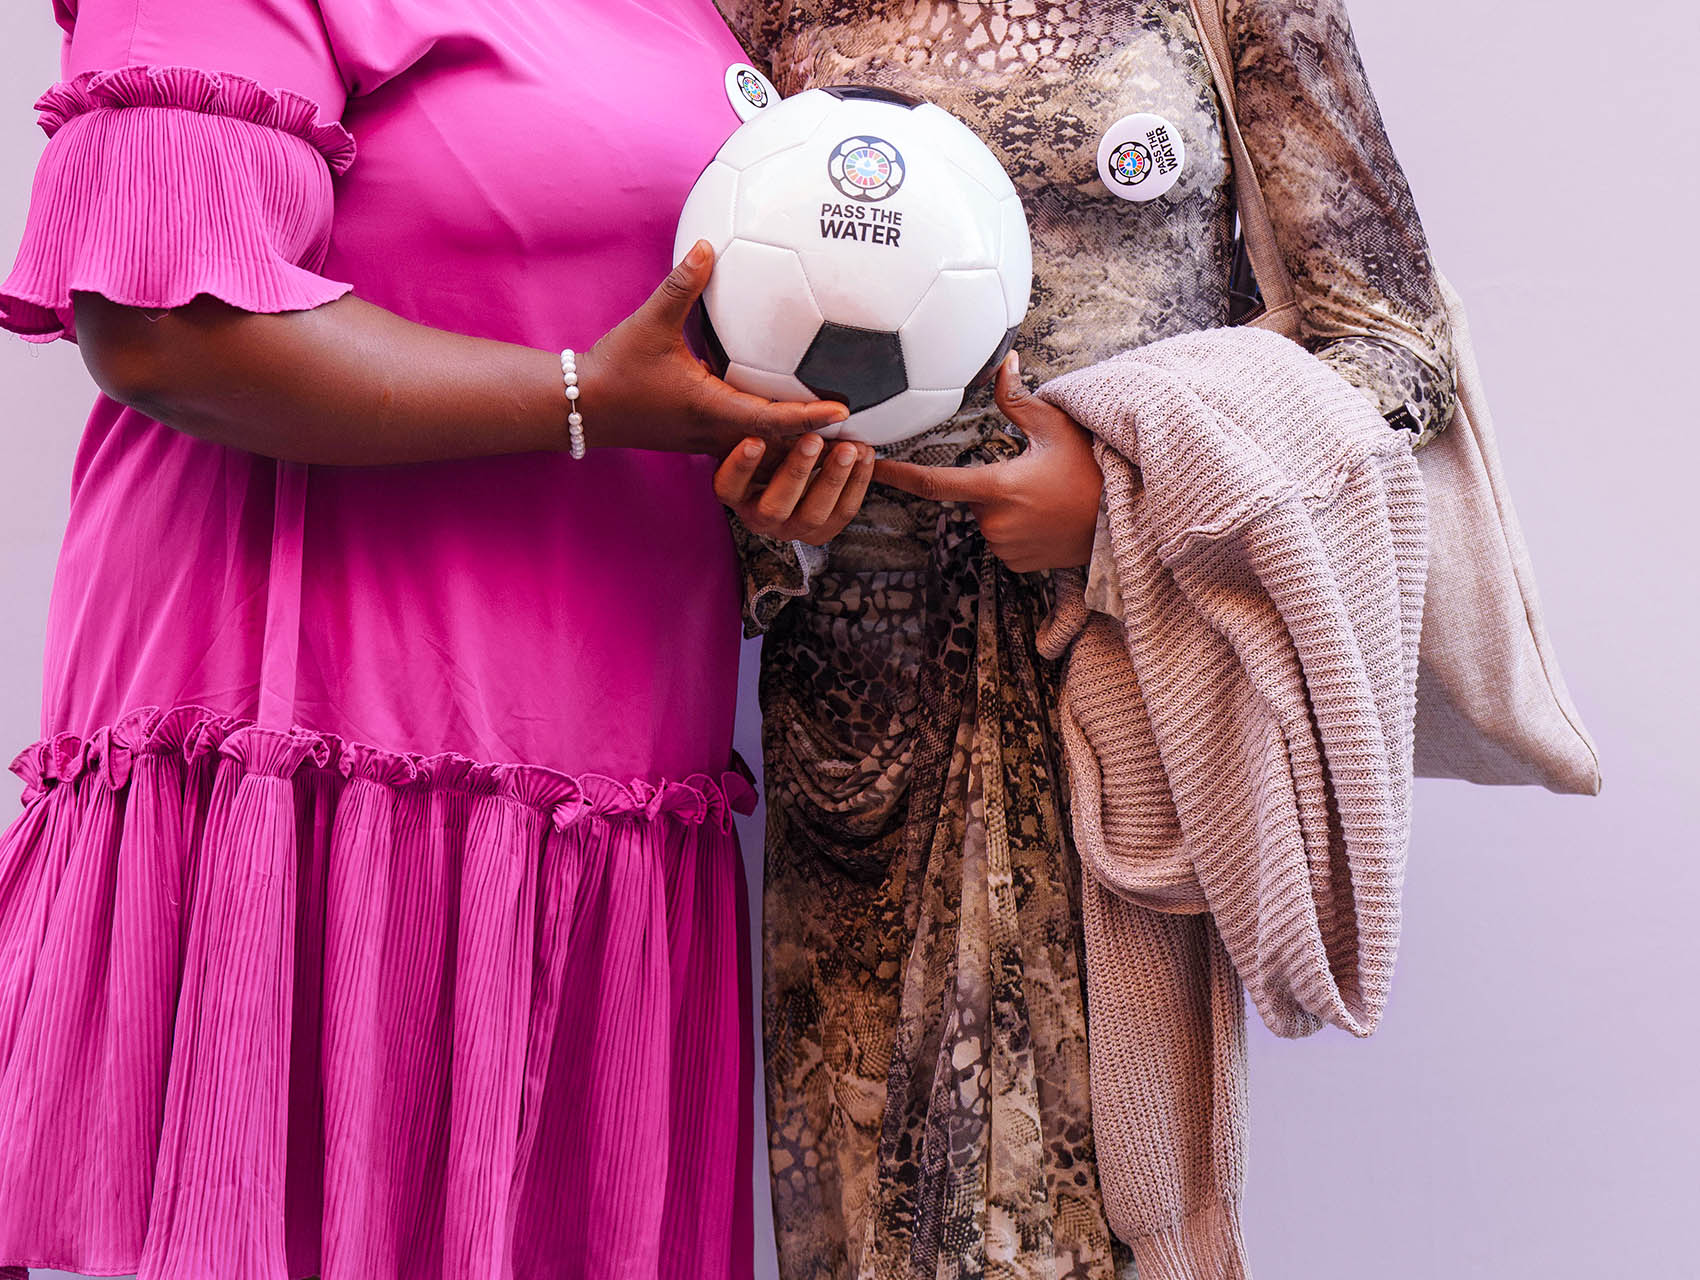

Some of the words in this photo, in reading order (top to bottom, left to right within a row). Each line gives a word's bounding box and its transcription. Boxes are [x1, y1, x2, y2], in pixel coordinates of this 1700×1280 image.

[1146, 130, 1159, 150] THE
[1155, 125, 1178, 172] WATER
[1153, 150, 1168, 176] PASS
[821, 203, 866, 220] PASS
[870, 207, 903, 226] THE
[820, 219, 901, 248] WATER
